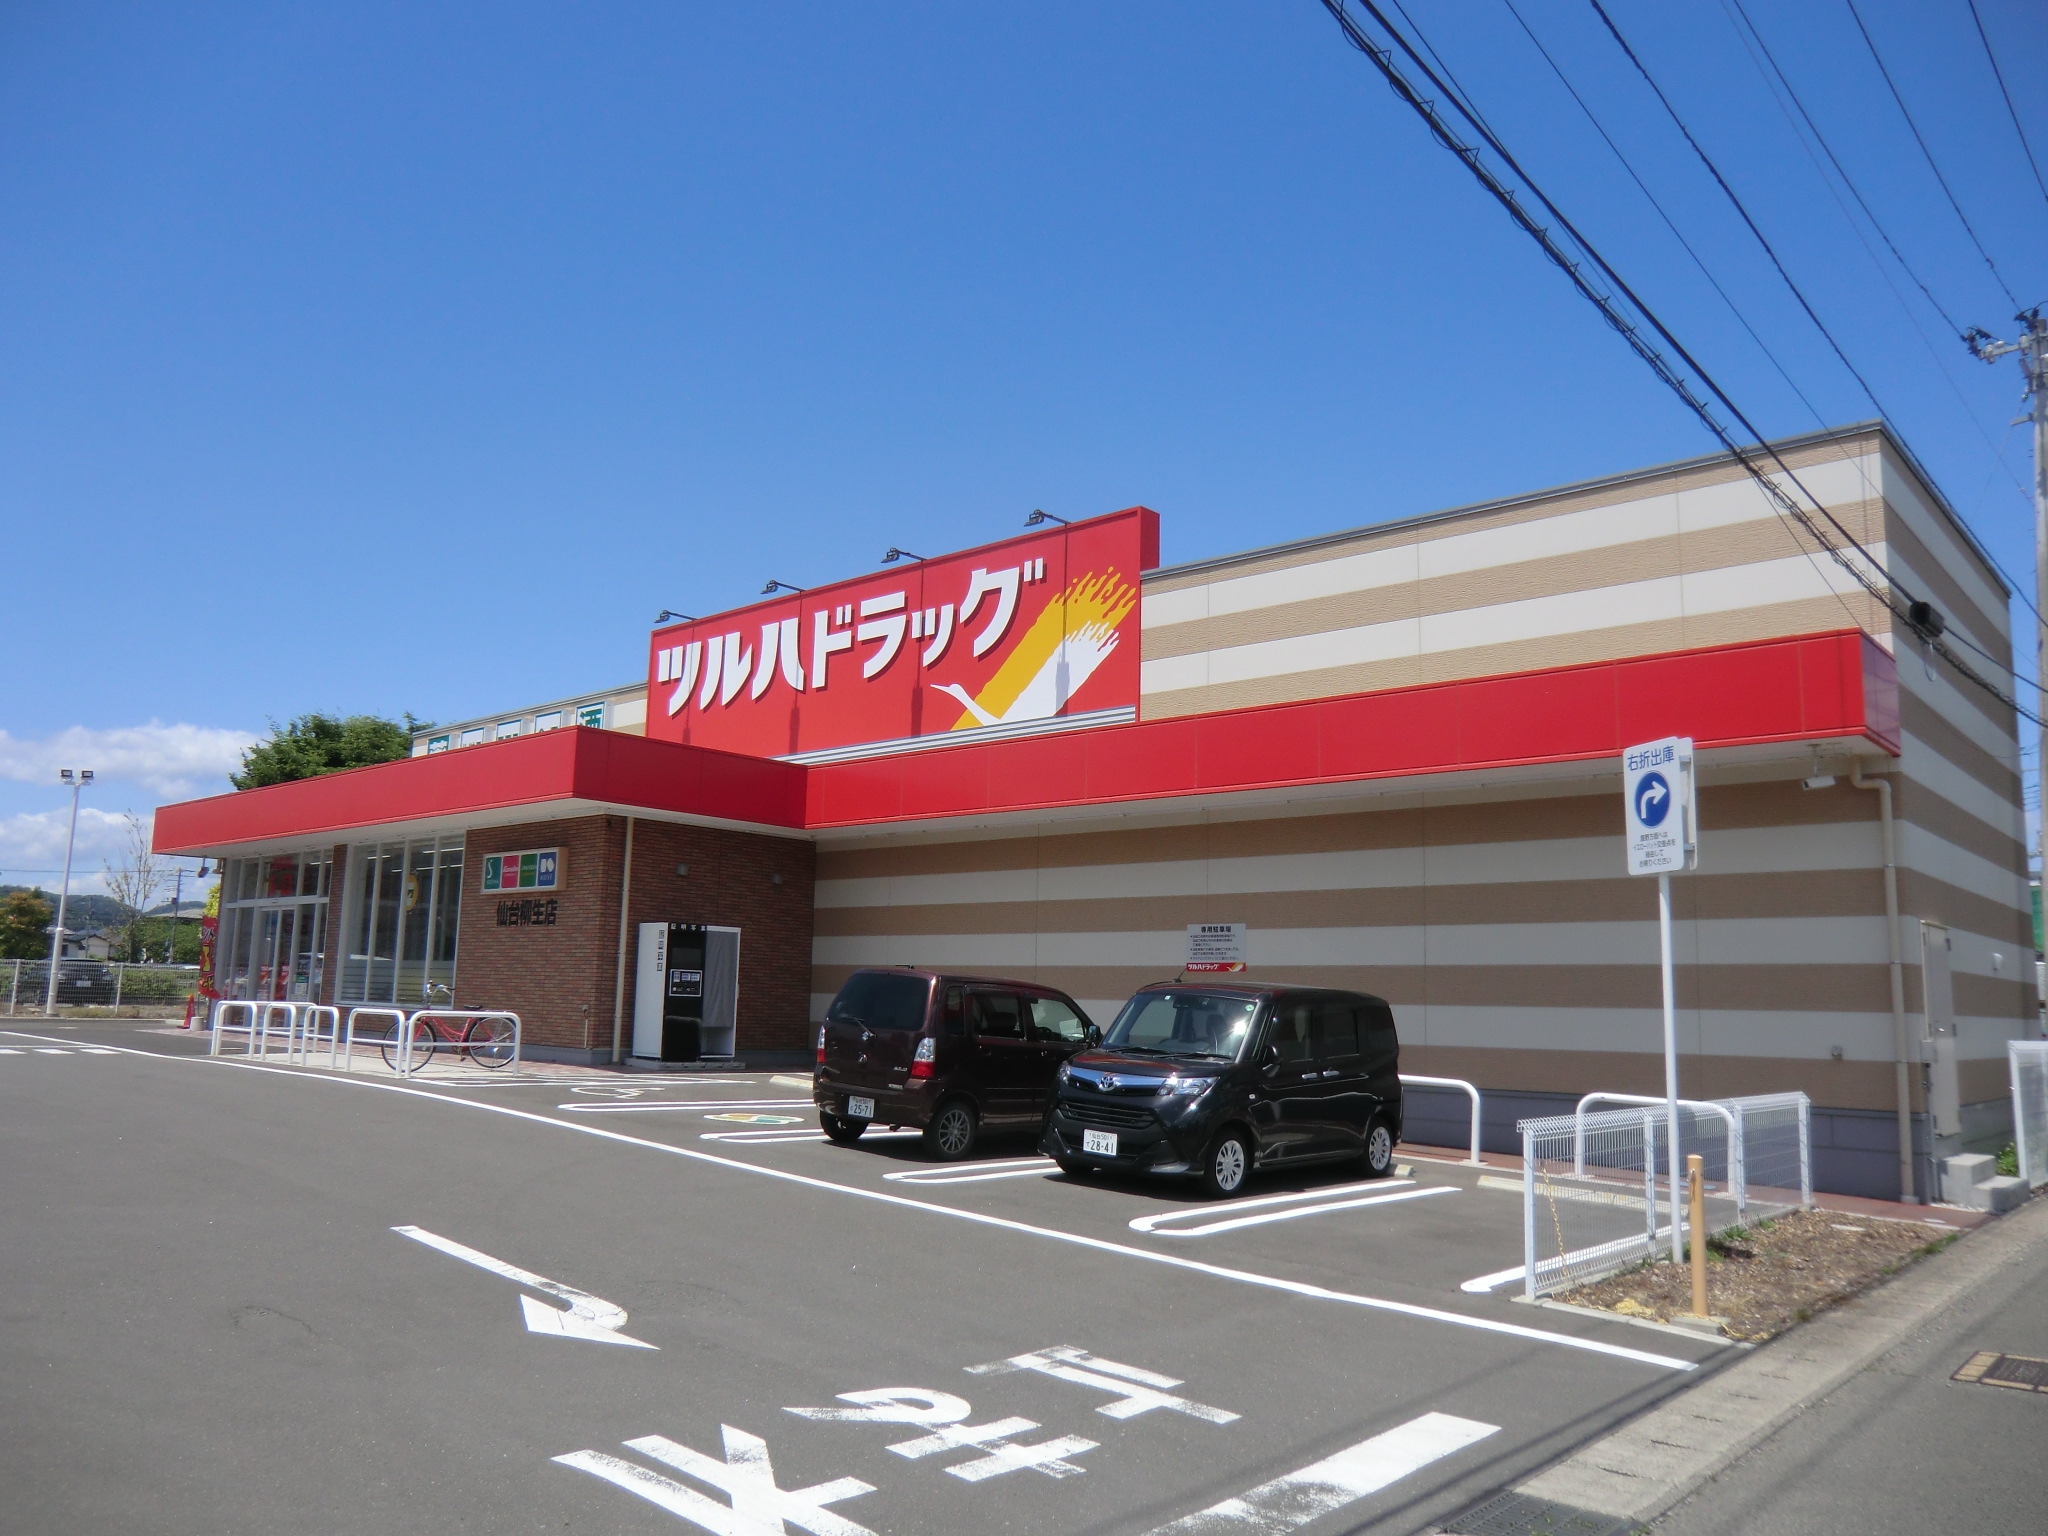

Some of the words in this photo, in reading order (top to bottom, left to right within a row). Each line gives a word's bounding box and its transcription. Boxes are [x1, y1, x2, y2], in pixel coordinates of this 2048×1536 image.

[657, 557, 1044, 717] ツルハドラッグ
[1627, 745, 1674, 771] 右折出庫
[496, 898, 558, 926] 仙台柳生店
